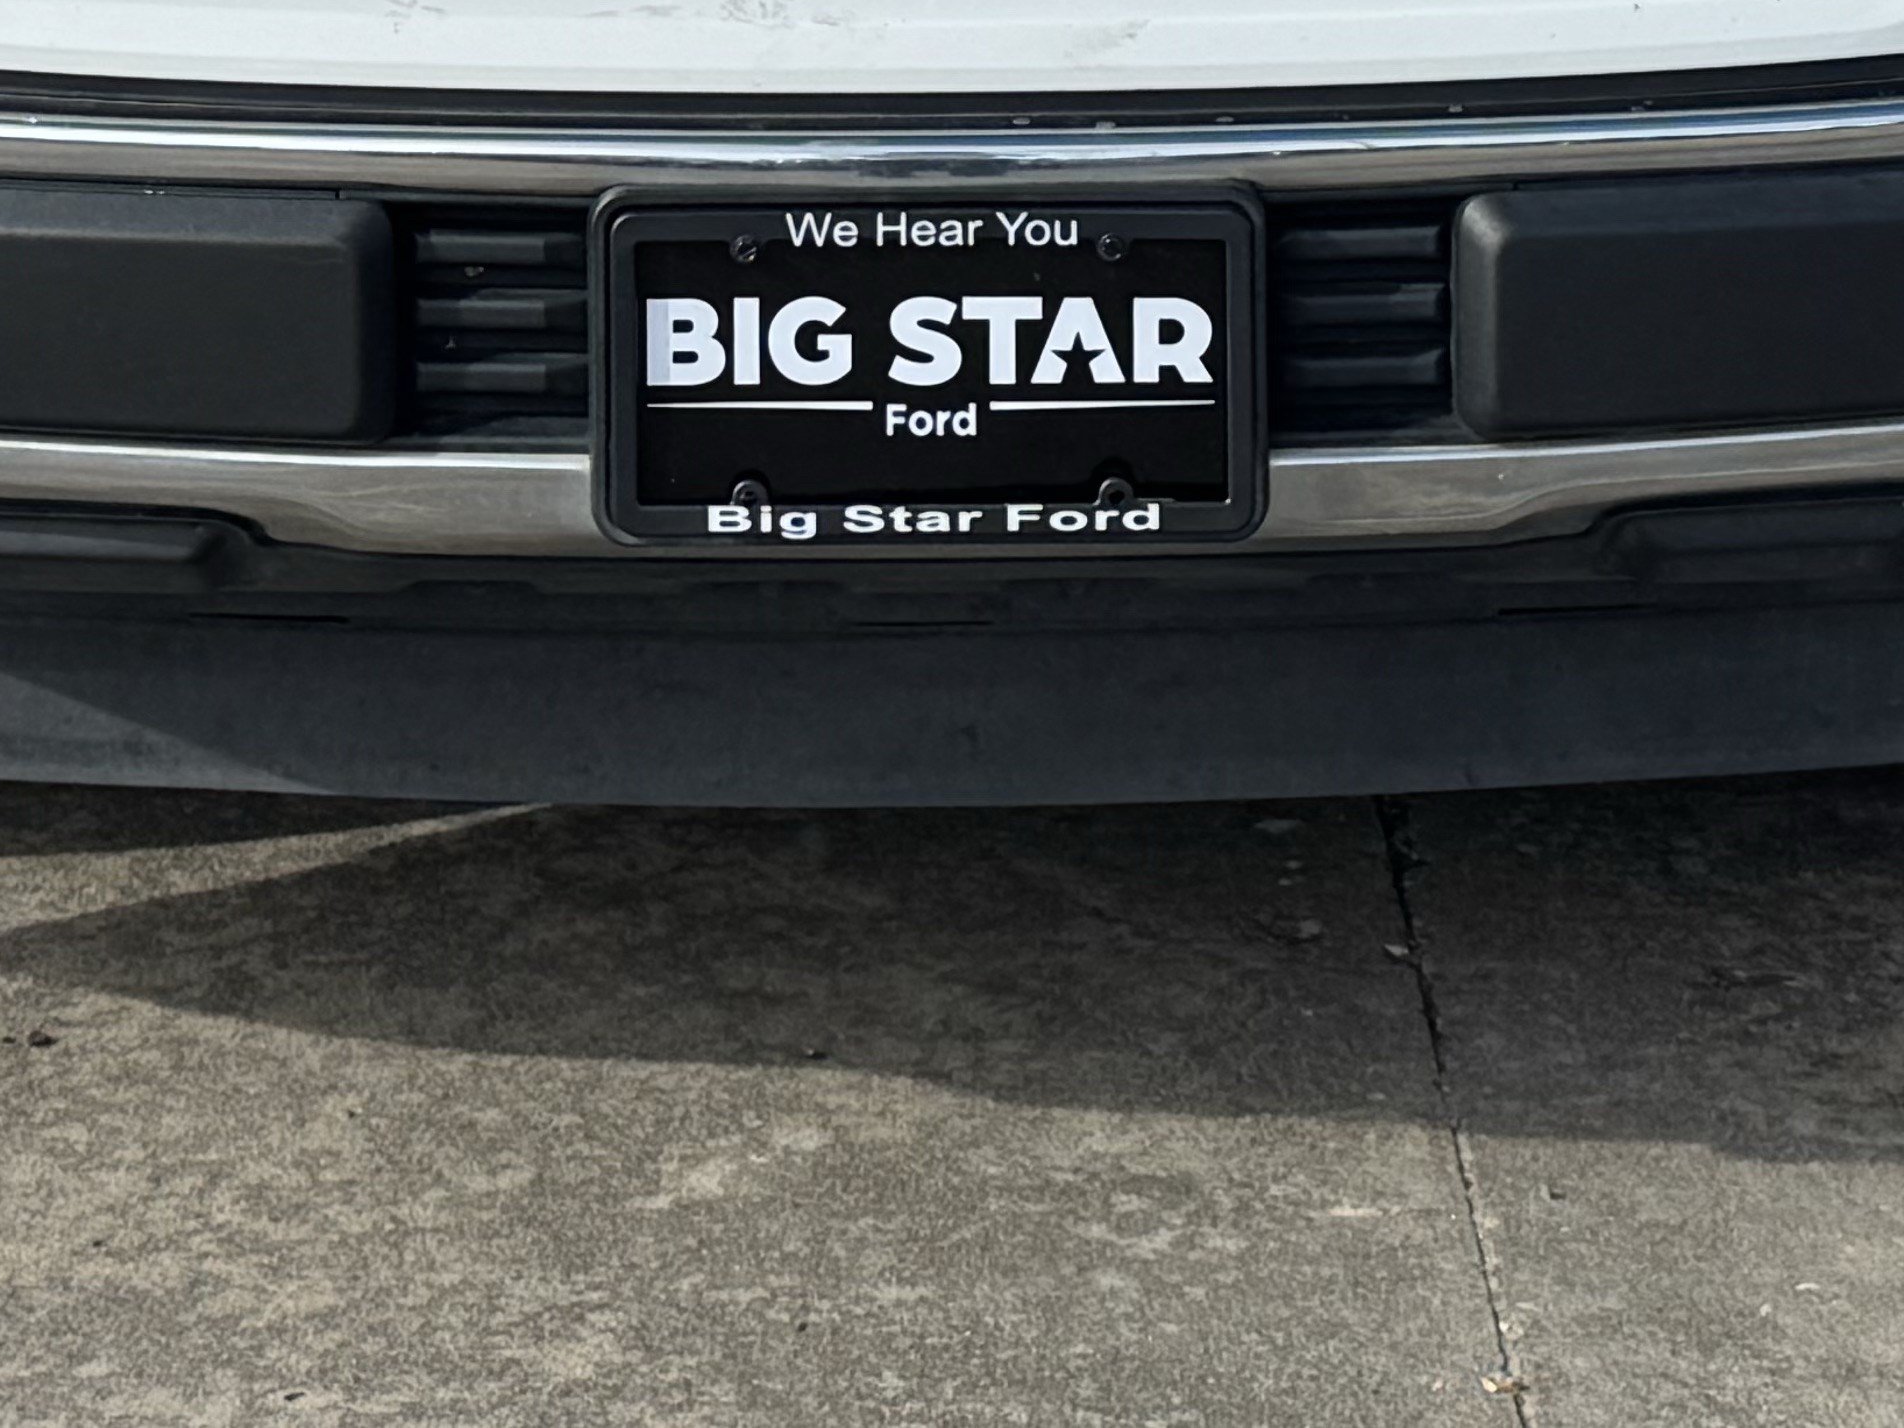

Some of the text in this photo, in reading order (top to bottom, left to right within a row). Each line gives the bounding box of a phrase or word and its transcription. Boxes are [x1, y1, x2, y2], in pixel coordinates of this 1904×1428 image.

[785, 210, 1079, 249] We Hear You
[646, 295, 1214, 387] BIG STAR
[885, 402, 977, 437] Ford
[707, 502, 1161, 540] Big Star Ford
